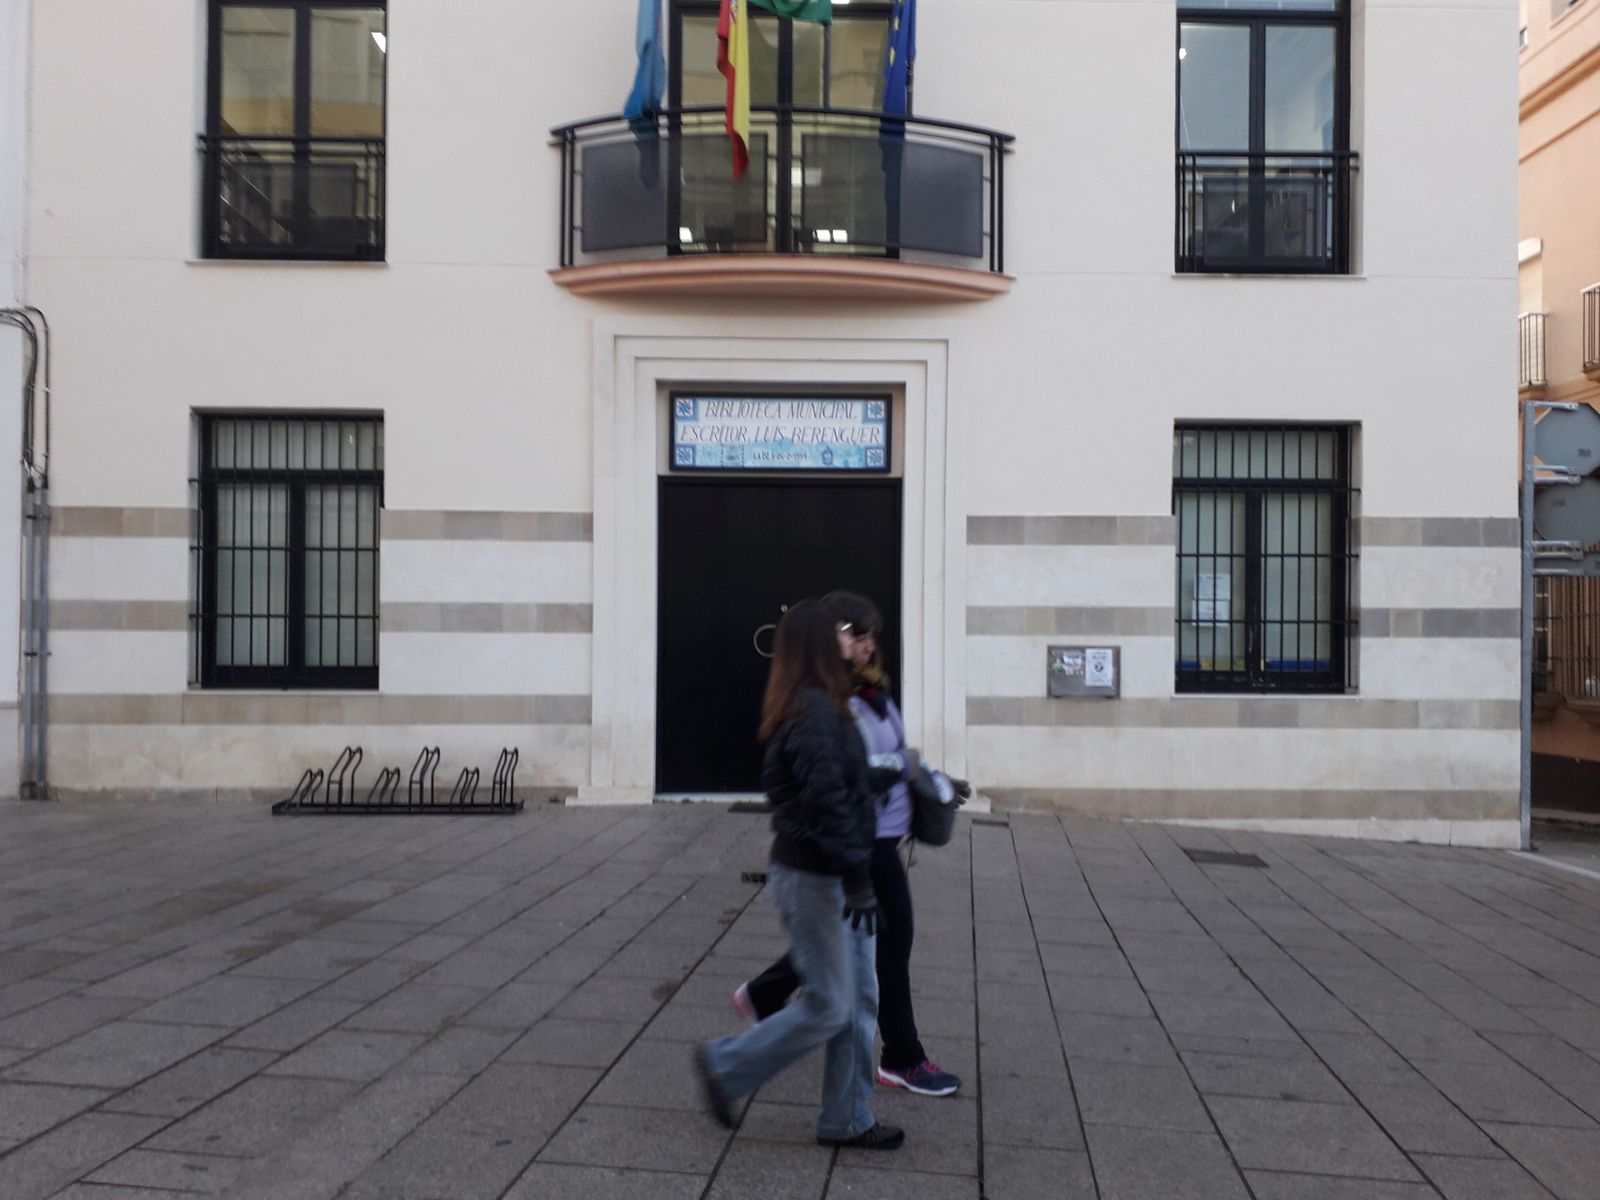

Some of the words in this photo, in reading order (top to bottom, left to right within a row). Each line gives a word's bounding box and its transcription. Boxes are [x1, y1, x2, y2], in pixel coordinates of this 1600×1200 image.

[705, 400, 781, 419] BIBLIOTECA
[787, 400, 857, 420] MUNICIPAL
[680, 423, 748, 443] ESCRITOR
[791, 425, 880, 444] BERENGUER
